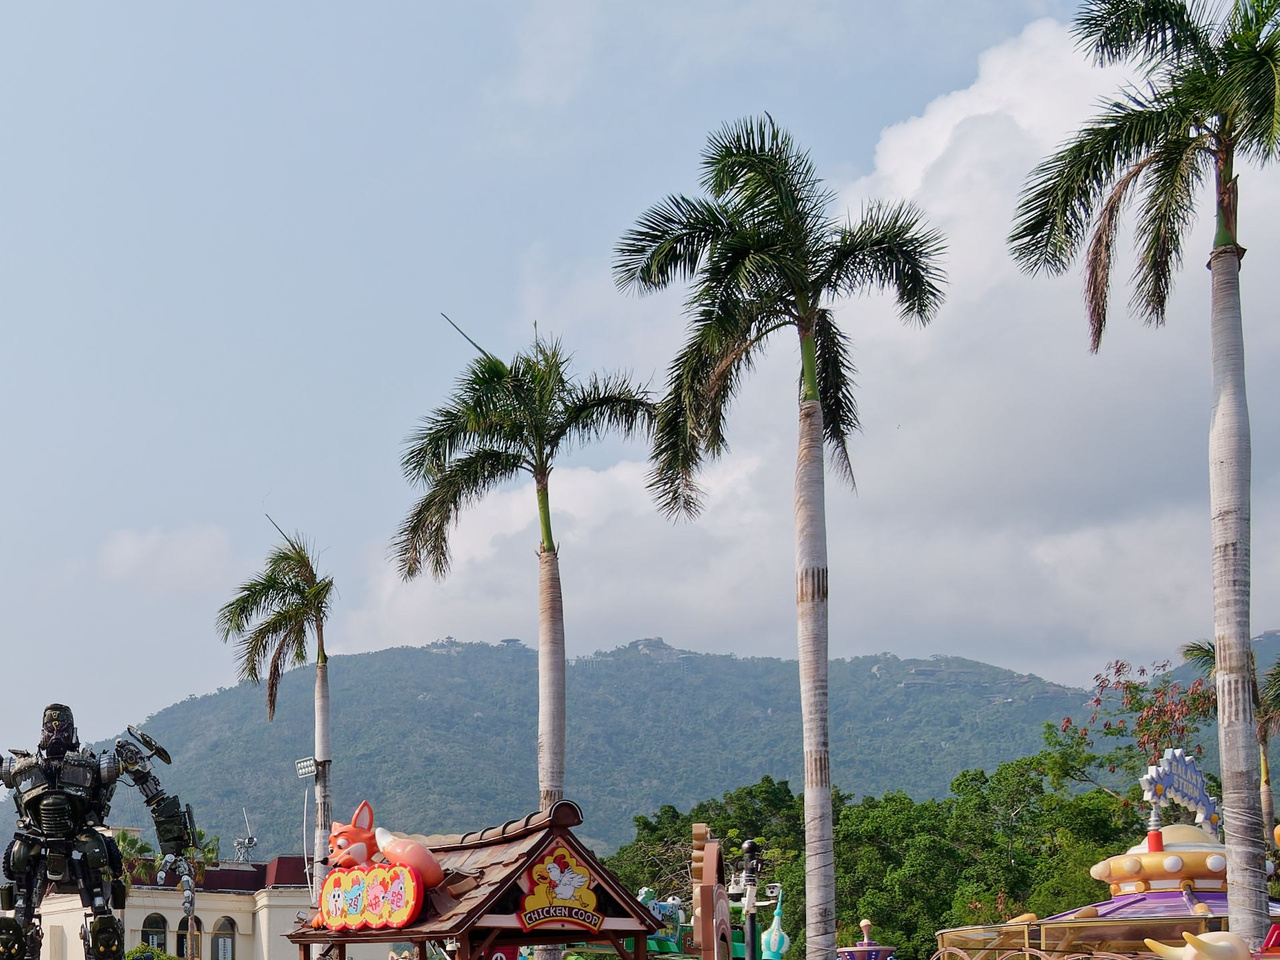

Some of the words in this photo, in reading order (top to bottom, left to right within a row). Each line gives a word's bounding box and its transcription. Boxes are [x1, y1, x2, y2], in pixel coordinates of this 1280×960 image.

[1172, 761, 1202, 788] GALAXY
[1174, 775, 1200, 800] STORM
[331, 890, 403, 916] 小鸡快跑
[526, 907, 568, 923] CHICKEN
[572, 908, 599, 925] COOP
